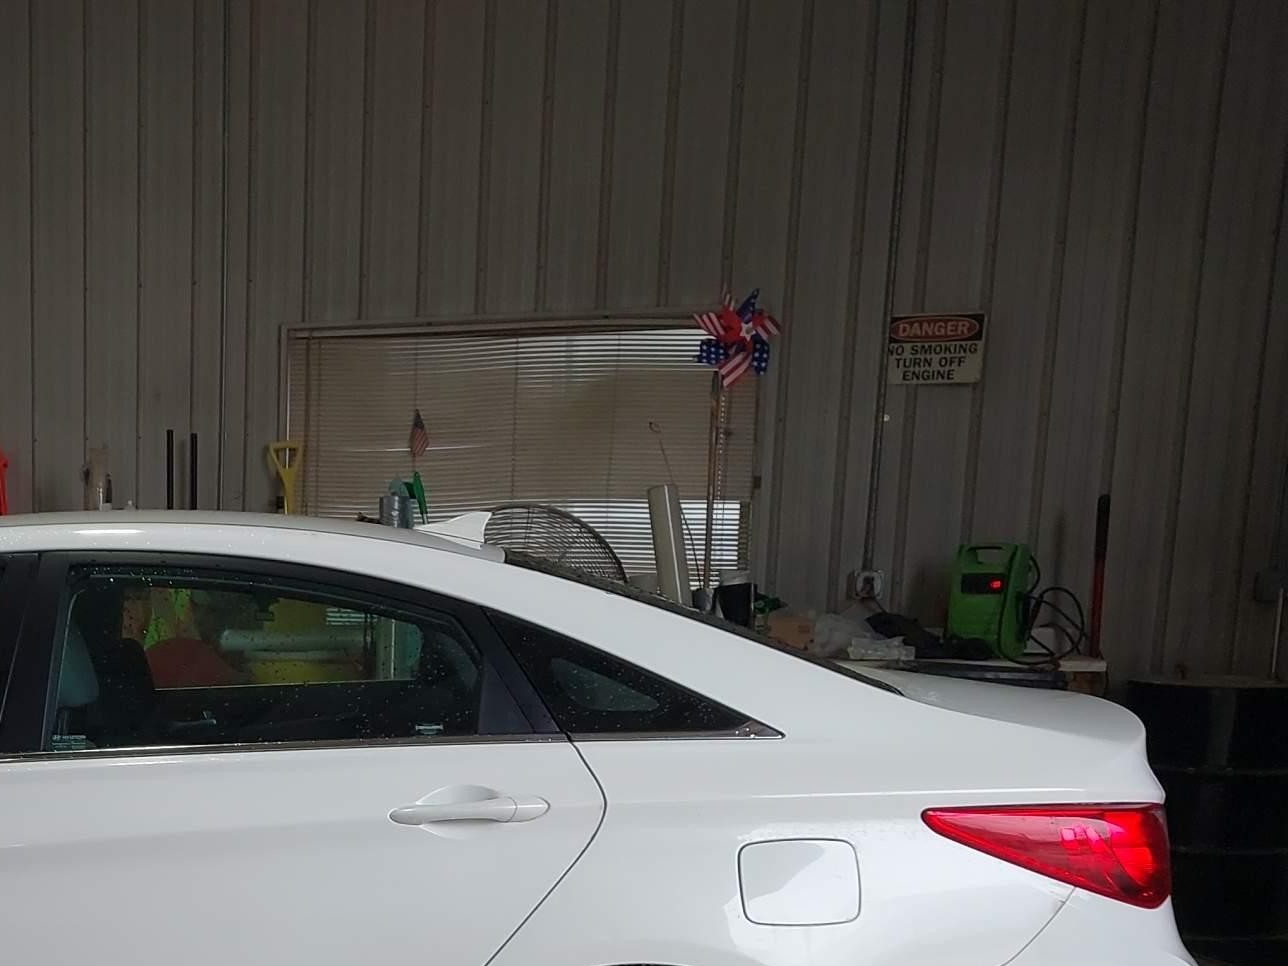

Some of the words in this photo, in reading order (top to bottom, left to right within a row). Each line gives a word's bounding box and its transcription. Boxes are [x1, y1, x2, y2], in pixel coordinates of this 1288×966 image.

[898, 320, 971, 337] DANGER
[910, 342, 979, 355] SMOKING
[894, 357, 933, 369] TURN
[938, 355, 967, 368] OFF
[902, 369, 956, 381] ENGINE
